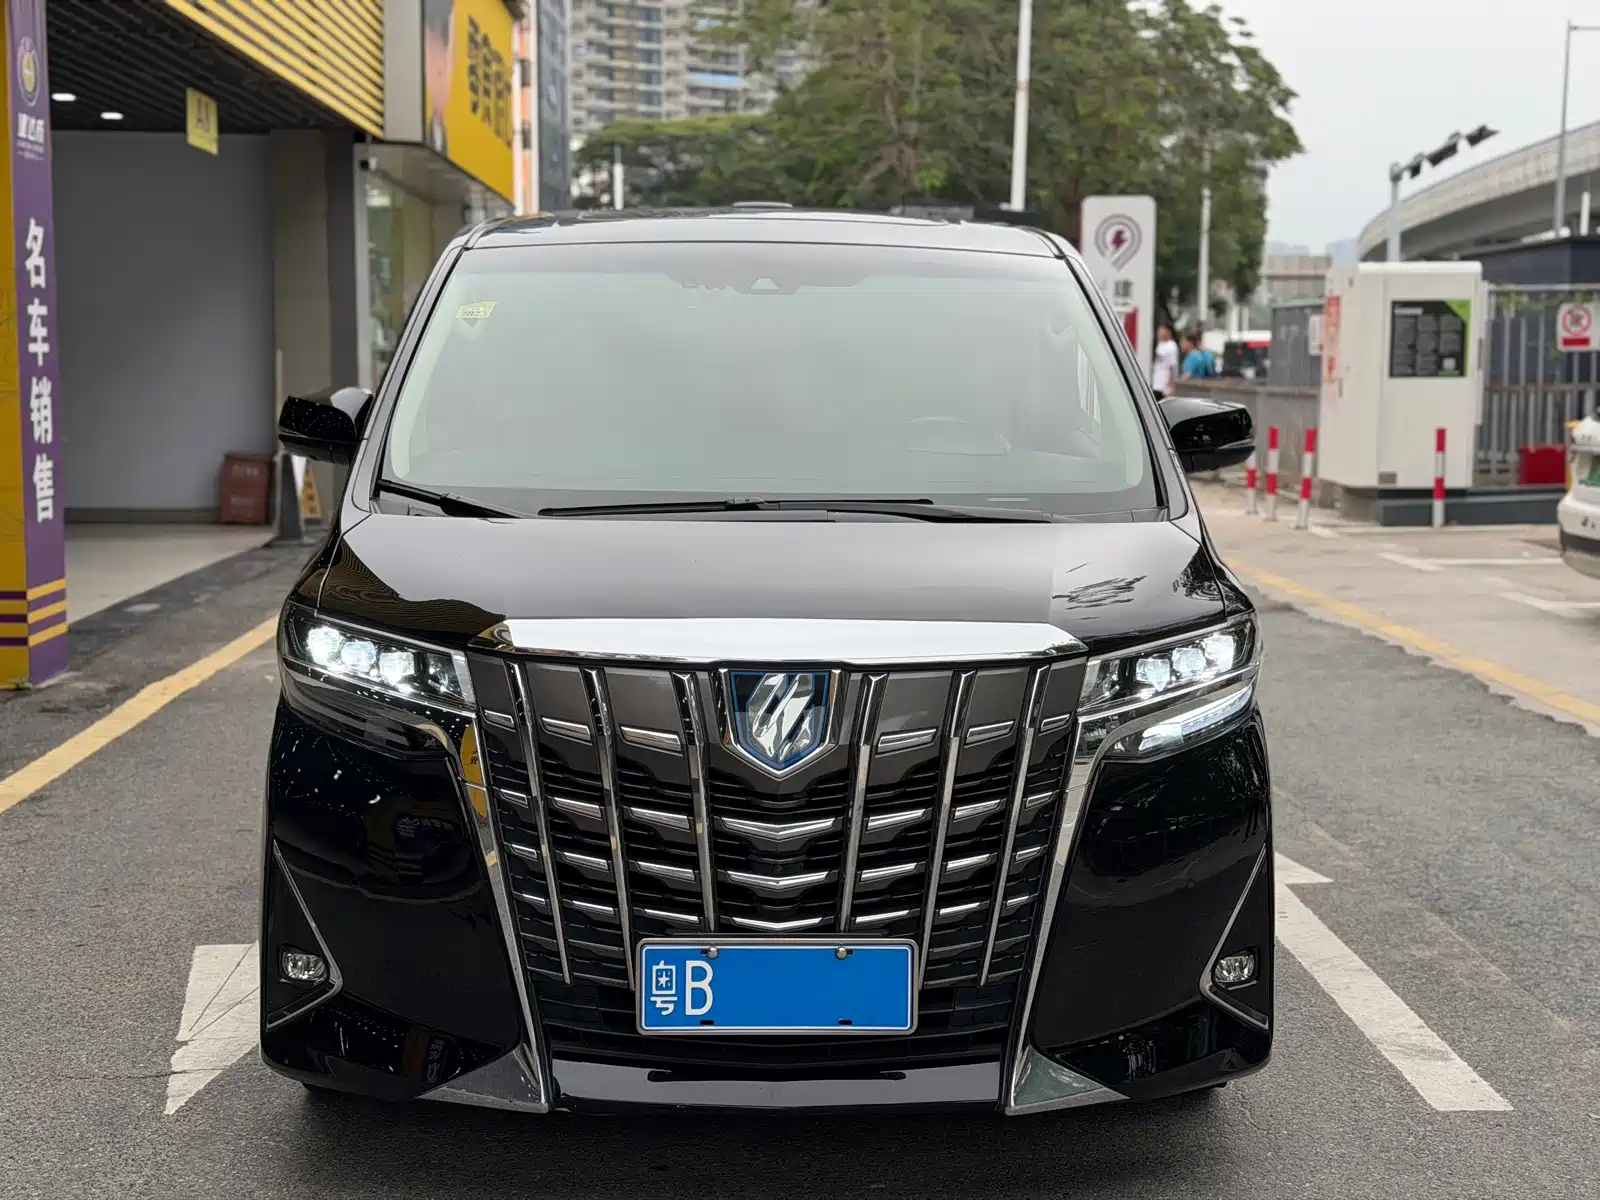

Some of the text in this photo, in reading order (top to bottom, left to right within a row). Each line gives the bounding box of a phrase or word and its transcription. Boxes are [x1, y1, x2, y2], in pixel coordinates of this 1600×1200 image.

[25, 217, 54, 523] 名车销售
[650, 960, 714, 1016] 粤B
